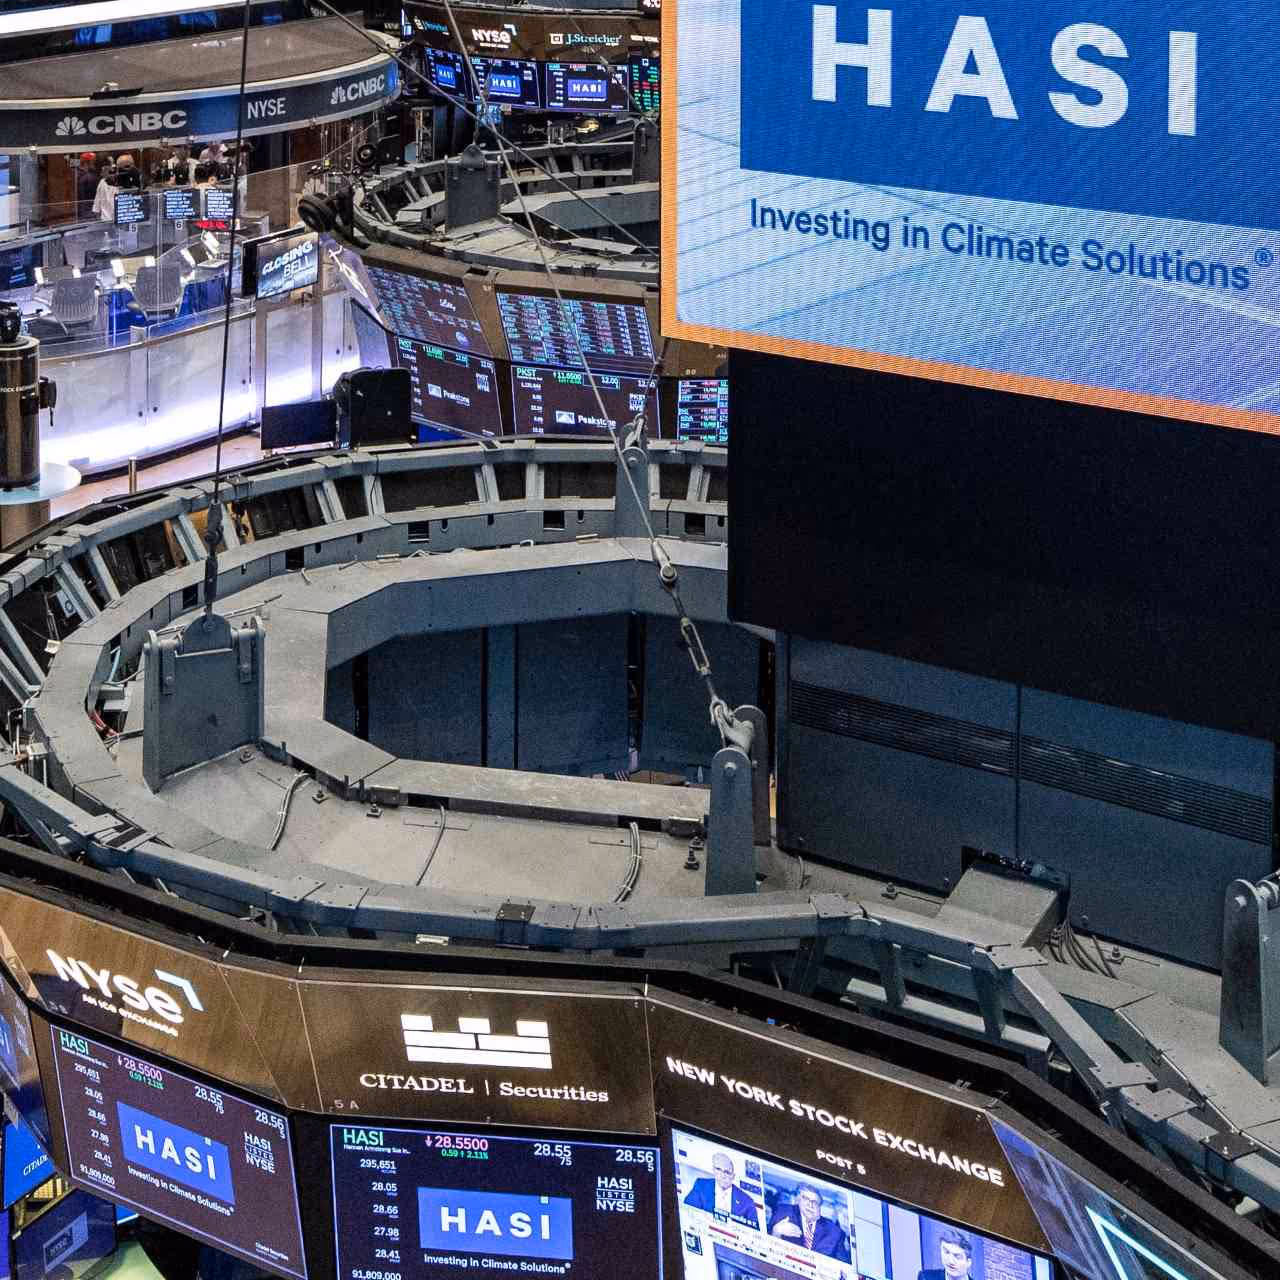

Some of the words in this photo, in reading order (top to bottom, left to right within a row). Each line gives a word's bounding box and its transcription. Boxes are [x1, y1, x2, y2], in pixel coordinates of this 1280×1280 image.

[811, 4, 1199, 137] HASI
[346, 73, 386, 102] CNBC
[247, 97, 287, 120] NYSE
[87, 109, 187, 136] CNBC
[750, 198, 890, 252] Investing
[902, 215, 930, 249] in
[941, 221, 1070, 268] Climate
[262, 240, 313, 275] CLOSING
[283, 255, 312, 277] BELL
[60, 1031, 90, 1055] HASI
[124, 1057, 163, 1081] 28.5500
[195, 1085, 223, 1106] 28.55
[255, 1109, 284, 1130] 28.56
[359, 1073, 475, 1094] CITADEL
[499, 1081, 609, 1102] Securities
[665, 1055, 716, 1087] NEW
[720, 1074, 785, 1111] YORK
[788, 1099, 869, 1140] STOCK
[872, 1126, 1005, 1189] EXCHANGE
[134, 1123, 217, 1180] HASI
[243, 1132, 271, 1151] HASI
[343, 1128, 384, 1146] HASI
[434, 1135, 488, 1152] 28.5500
[534, 1143, 571, 1157] 28.55
[616, 1149, 654, 1164] 28.56
[245, 1154, 275, 1174] NYSE
[360, 1158, 397, 1170] 295,651
[441, 1149, 458, 1159] 0.59
[560, 1156, 571, 1166] 75
[815, 1148, 848, 1170] POST
[855, 1162, 867, 1176] 5
[128, 1165, 161, 1188] Investing
[169, 1183, 196, 1202] Climate
[372, 1181, 398, 1193] 28.05
[597, 1175, 633, 1191] HASI
[596, 1190, 634, 1200] LISTED
[372, 1204, 399, 1216] 28.66
[596, 1199, 635, 1214] NYSE
[373, 1226, 400, 1238] 27.98
[440, 1205, 551, 1241] HASI
[375, 1248, 401, 1260] 28.41
[424, 1254, 468, 1268] Investing
[470, 1258, 479, 1268] in
[481, 1258, 518, 1271] Climate
[352, 1269, 402, 1280] 91,809,000
